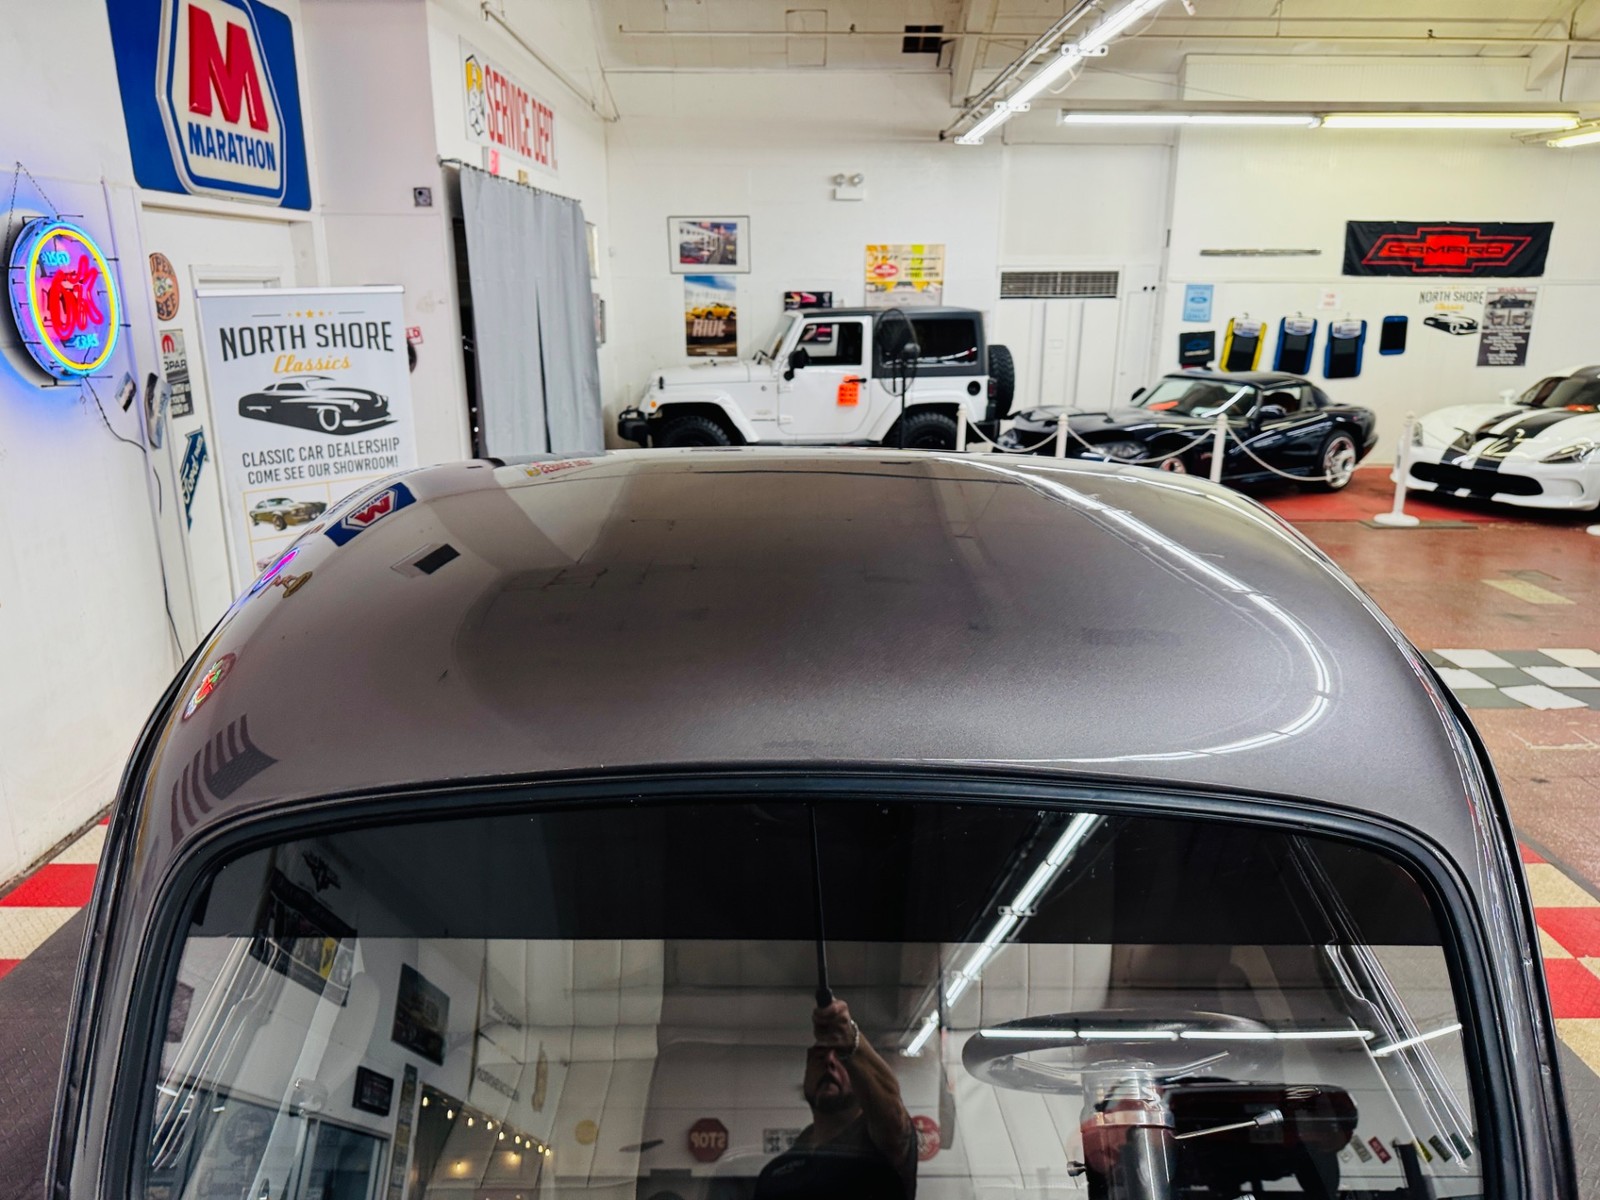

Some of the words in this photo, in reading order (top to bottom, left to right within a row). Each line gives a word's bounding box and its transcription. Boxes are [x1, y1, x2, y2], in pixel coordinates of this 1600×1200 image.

[485, 64, 531, 158] SERVICE
[187, 121, 277, 172] MARATHON
[151, 253, 174, 275] UPER
[1387, 244, 1504, 254] CAMARO
[219, 324, 307, 362] NORTH
[314, 321, 395, 352] SHORE
[272, 354, 353, 374] Classics
[242, 448, 296, 468] CLASSIC
[299, 444, 325, 461] CAR
[328, 437, 400, 459] DEALERSHIP
[247, 467, 282, 485] COME
[284, 464, 305, 481] SEE
[308, 461, 331, 478] OUR
[333, 455, 399, 475] SHOWROOM!
